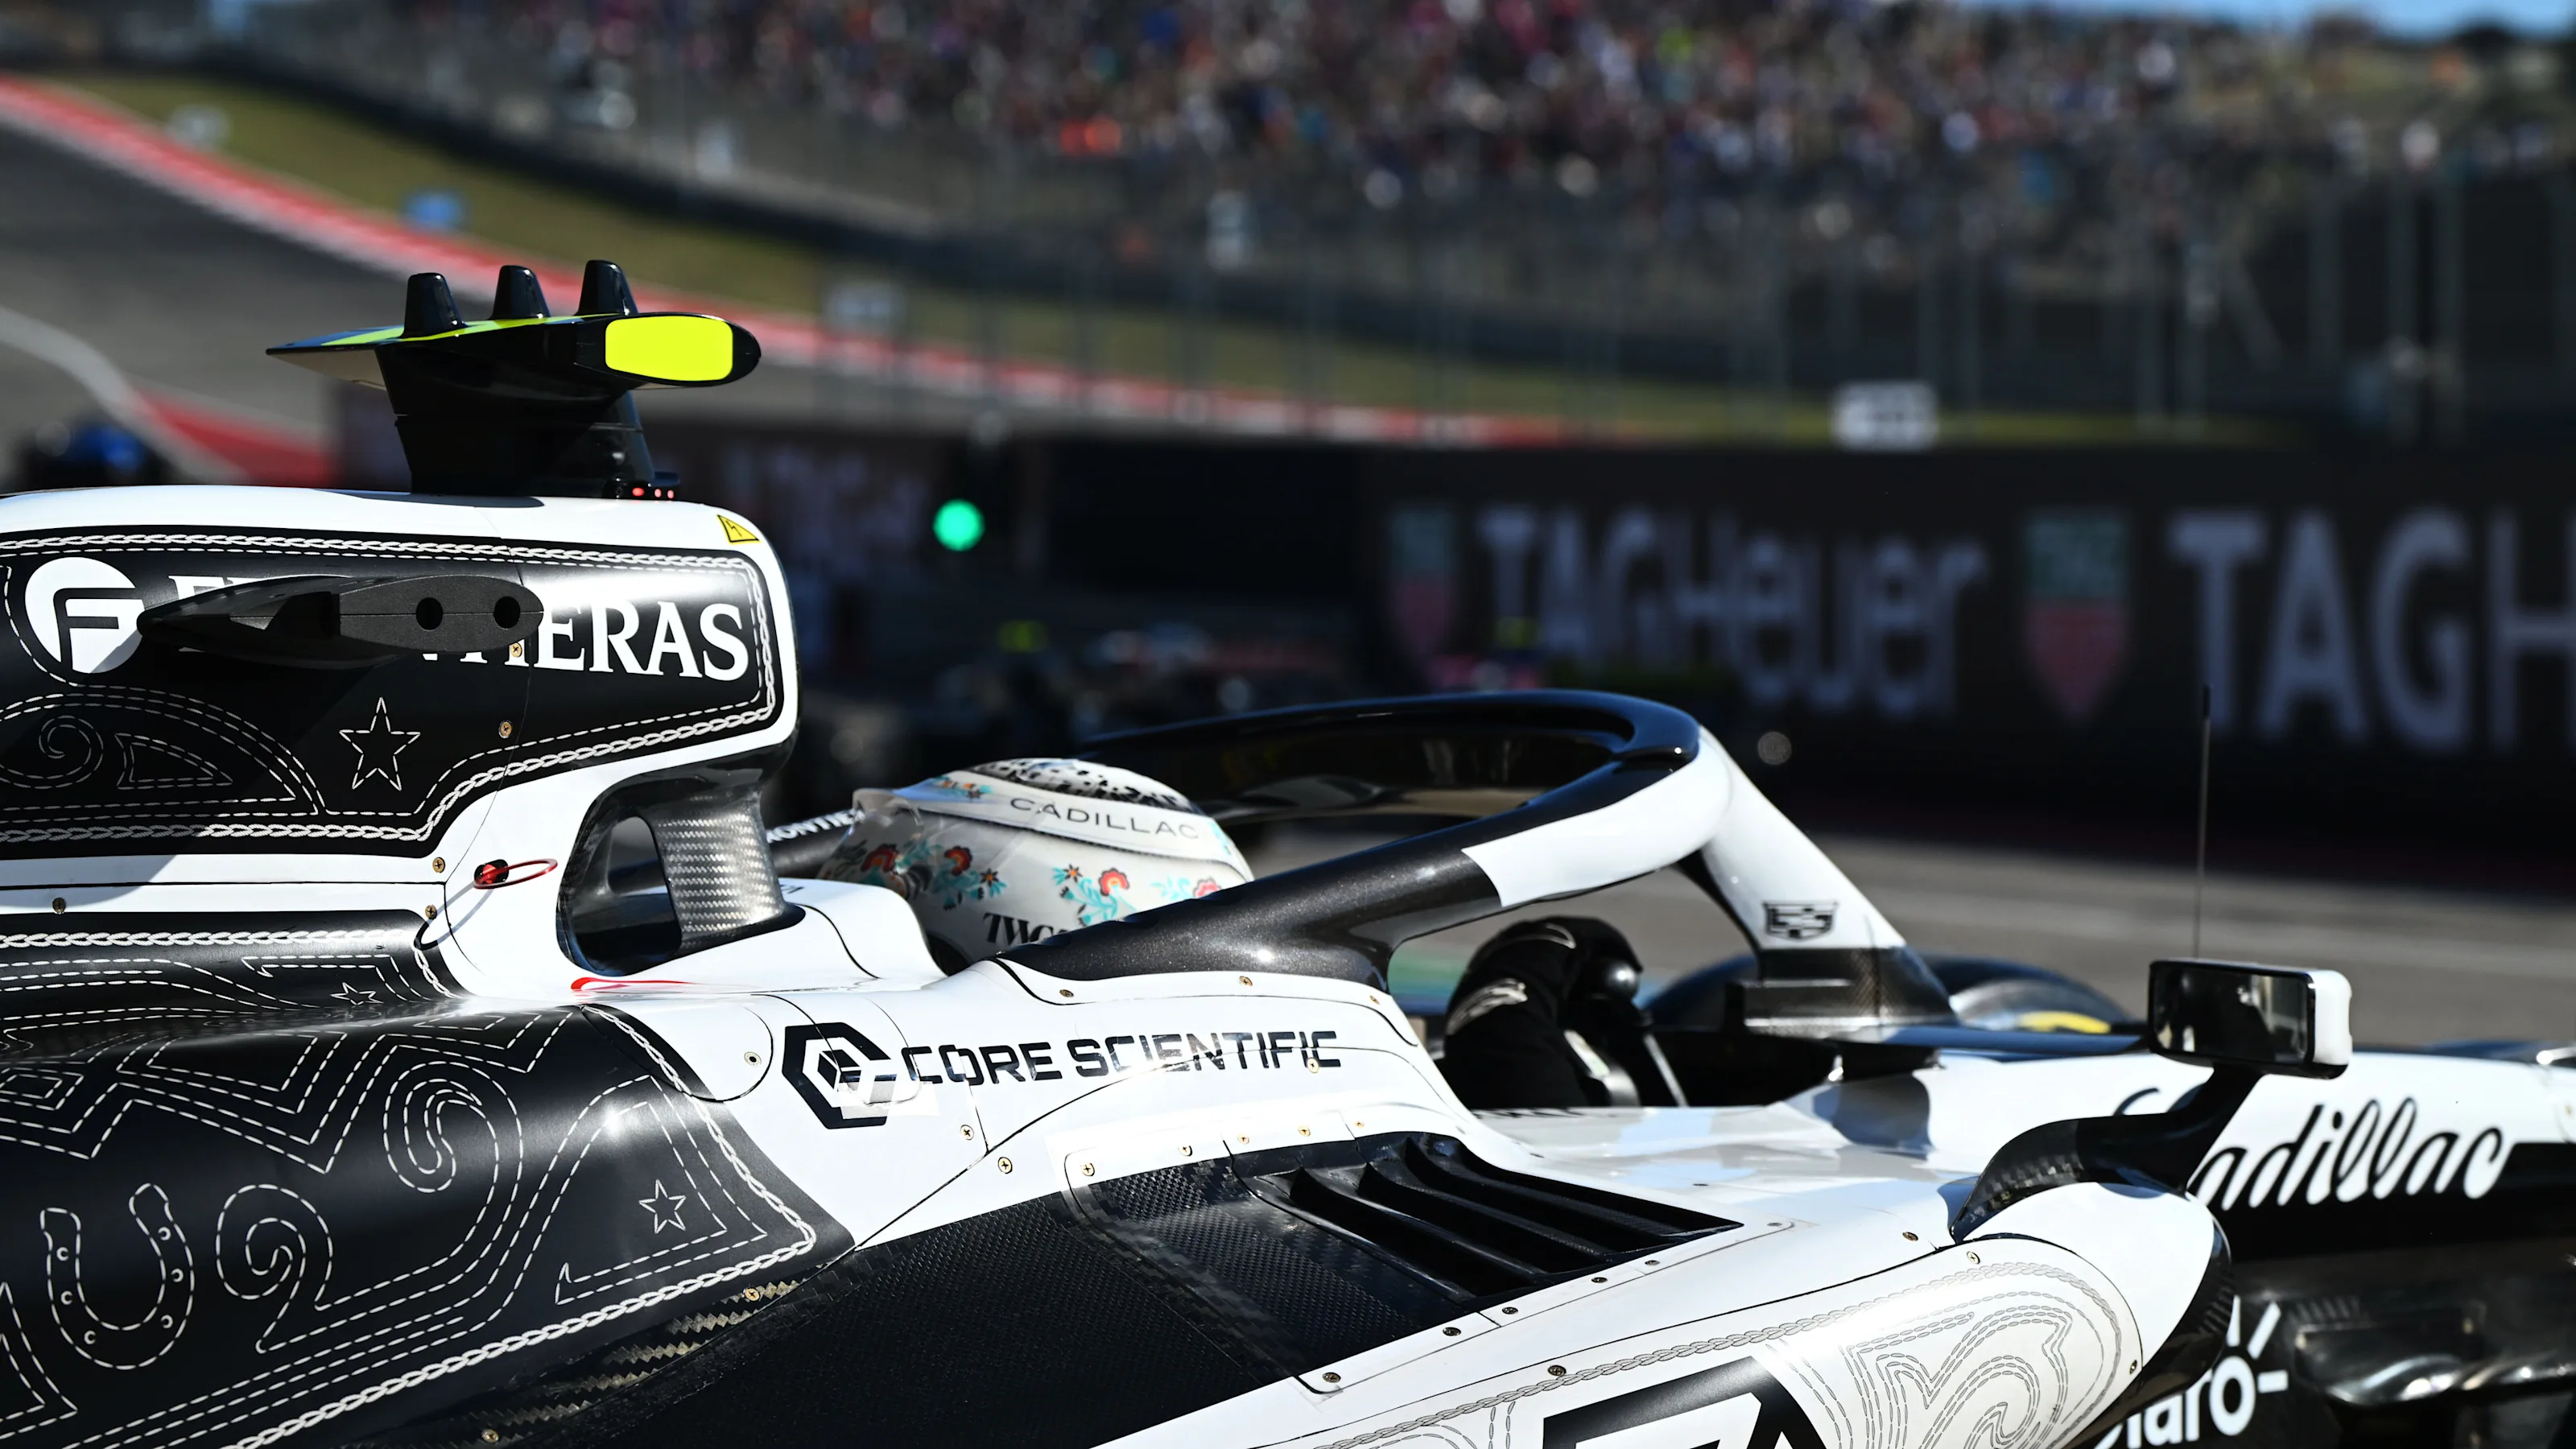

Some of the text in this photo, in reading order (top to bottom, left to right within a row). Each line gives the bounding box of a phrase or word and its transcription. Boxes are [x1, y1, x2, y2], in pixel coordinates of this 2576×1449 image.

[1010, 797, 1199, 839] CADILLAC
[901, 1030, 1342, 1087] CORE SCIENTIFIC
[2114, 1088, 2505, 1211] adillac
